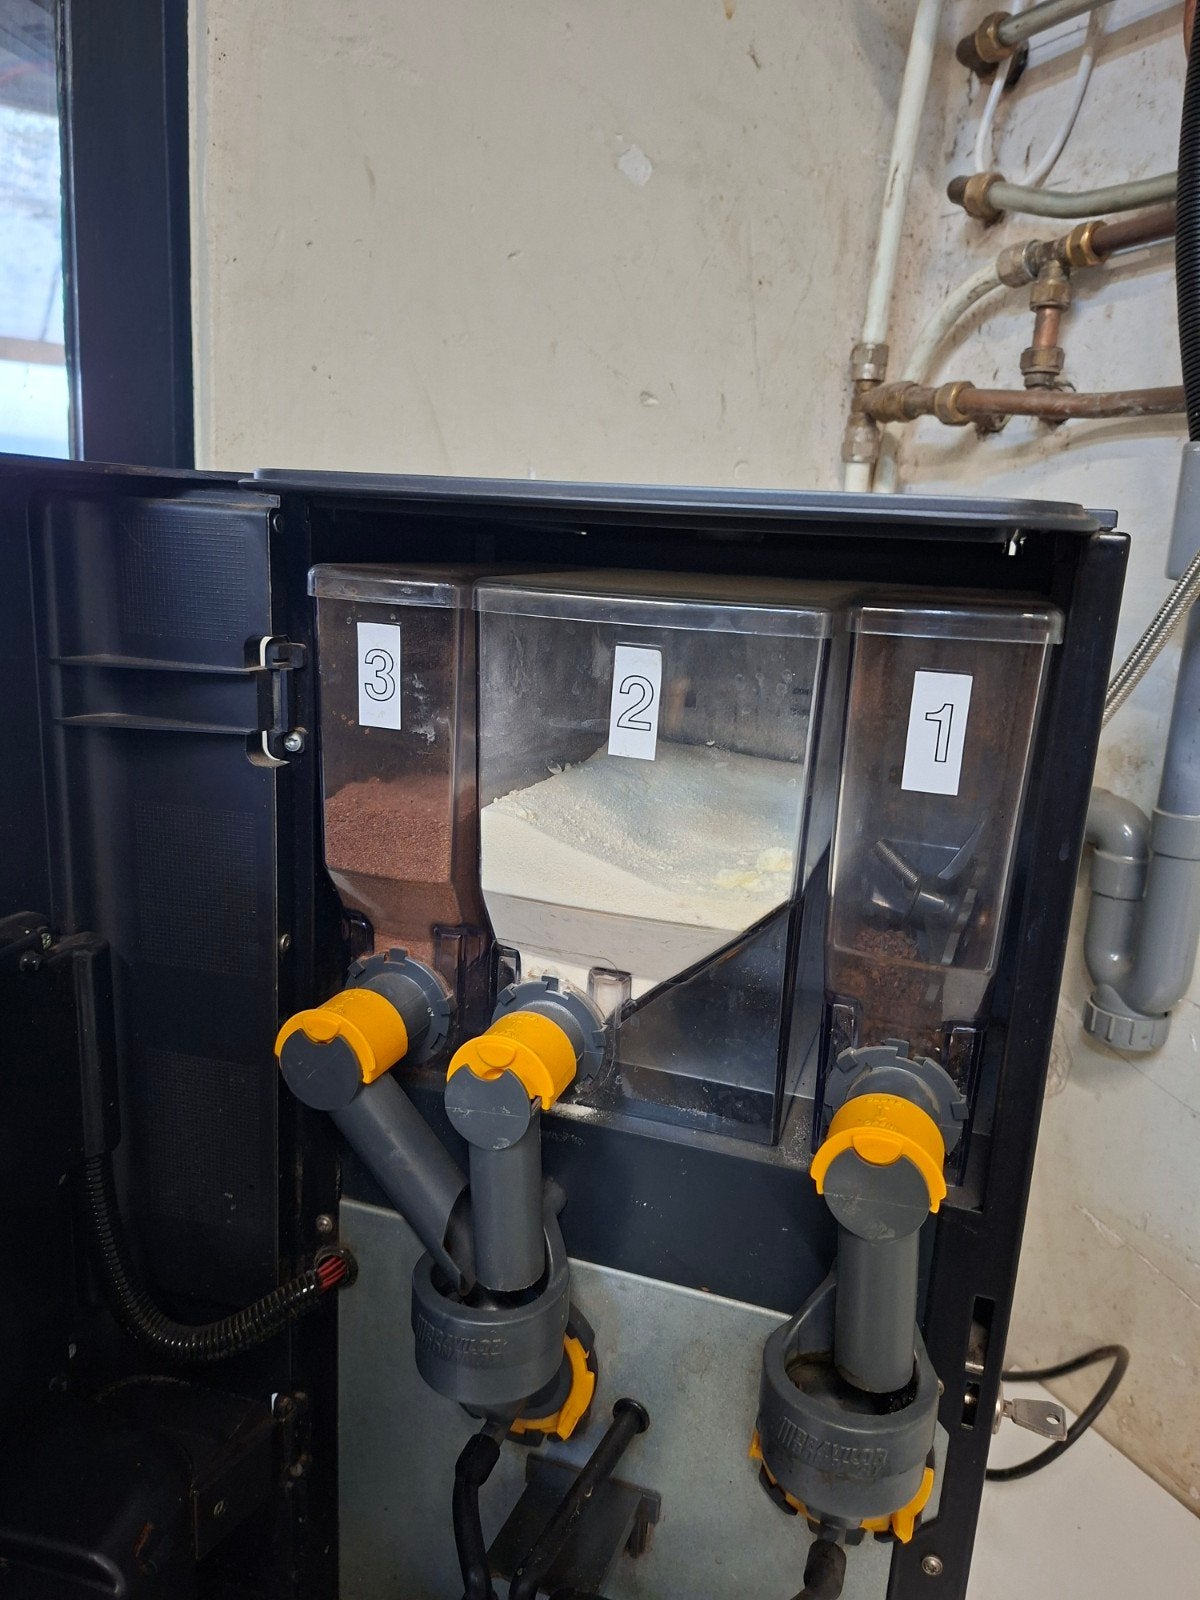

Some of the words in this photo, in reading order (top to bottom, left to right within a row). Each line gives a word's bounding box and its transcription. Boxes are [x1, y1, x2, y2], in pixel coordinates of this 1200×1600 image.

[364, 648, 395, 702] 3
[616, 674, 655, 731] 2
[925, 703, 954, 763] 1
